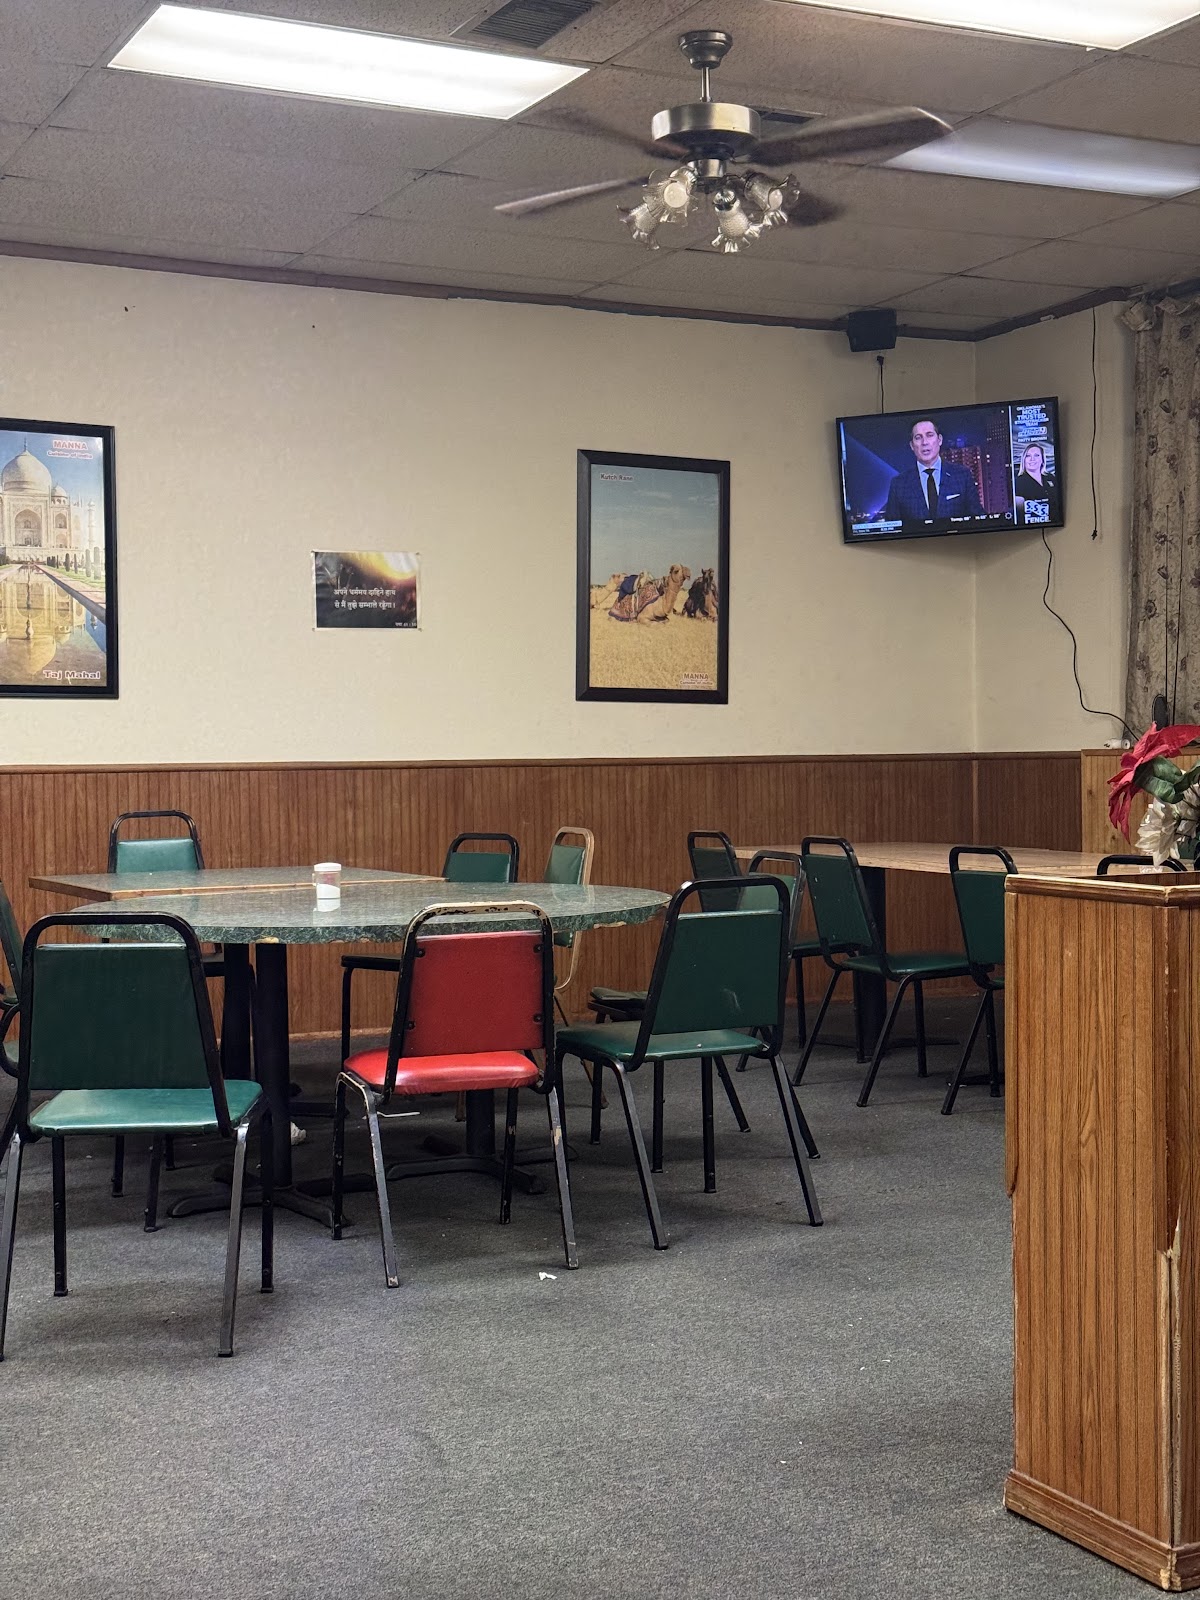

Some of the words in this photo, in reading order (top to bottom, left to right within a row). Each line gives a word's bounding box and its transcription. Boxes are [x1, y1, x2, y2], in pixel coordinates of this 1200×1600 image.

[1016, 413, 1047, 421] TRUSTED
[53, 440, 88, 450] MANNA
[1024, 513, 1050, 525] FENCE
[334, 587, 347, 595] अपने
[43, 670, 62, 680] Taj
[65, 670, 101, 680] Mahal
